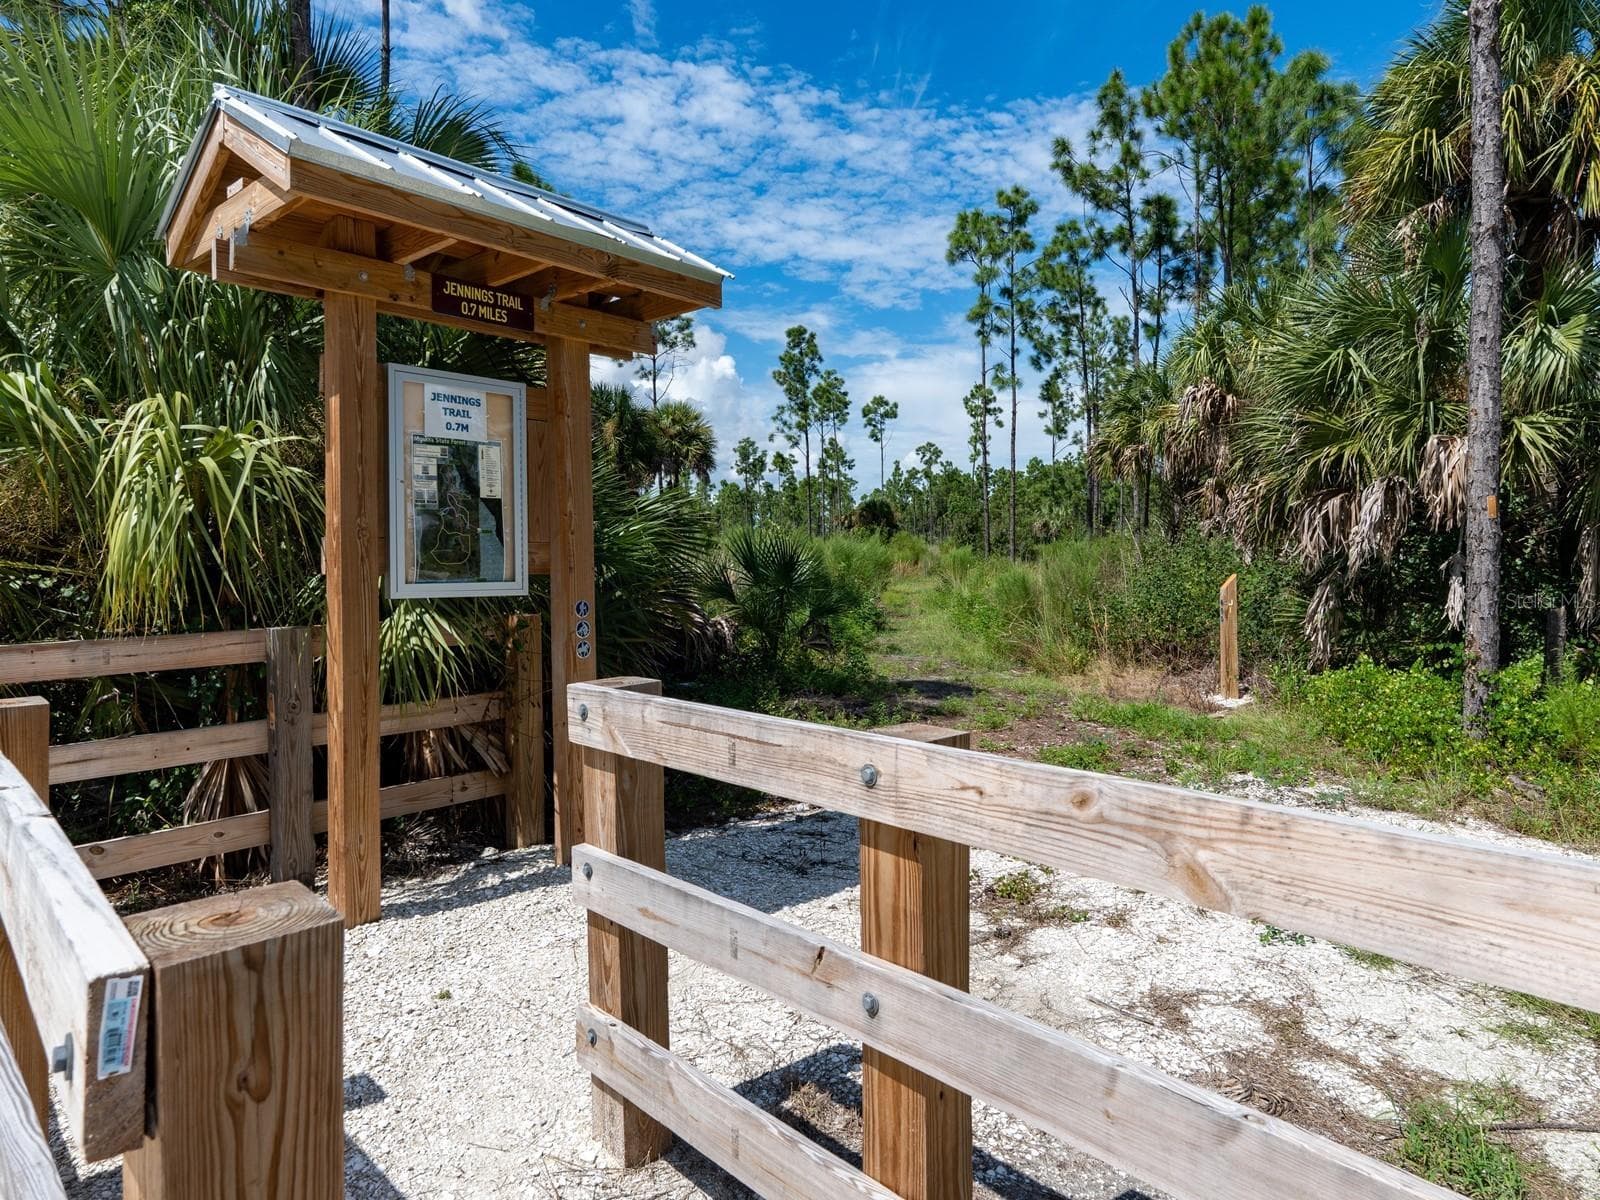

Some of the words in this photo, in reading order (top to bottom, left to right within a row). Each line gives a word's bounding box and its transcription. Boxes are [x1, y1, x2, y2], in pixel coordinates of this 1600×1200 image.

[443, 281, 494, 304] JENNINGS
[496, 292, 524, 311] TRAIL
[461, 301, 477, 316] 0.7
[479, 304, 508, 323] MILES
[430, 392, 482, 407] JENNINGS
[442, 406, 473, 419] TRAIL
[445, 421, 470, 433] 0.7M
